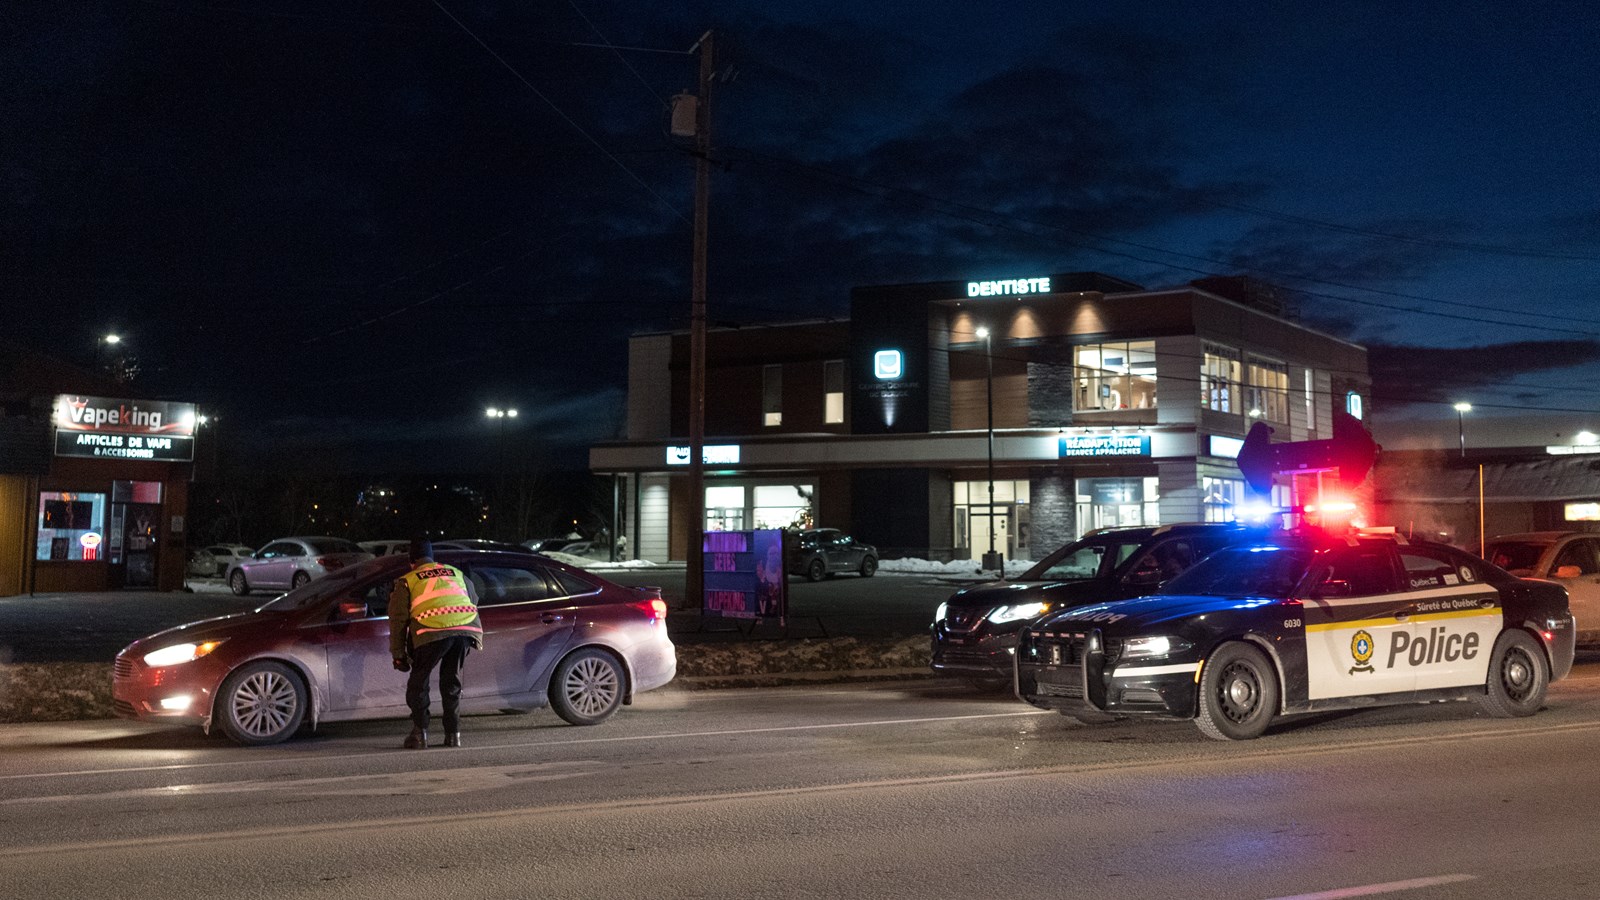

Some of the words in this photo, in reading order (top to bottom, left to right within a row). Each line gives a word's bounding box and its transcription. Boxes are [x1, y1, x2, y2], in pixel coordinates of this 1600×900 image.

[967, 277, 1051, 297] DENTISTE
[77, 434, 123, 447] ARTICLES
[128, 437, 142, 448] DE
[146, 438, 171, 449] VAPE
[94, 448, 99, 456] &
[101, 448, 153, 458] ACCESSOIRES
[1095, 447, 1141, 455] APPALACHES
[419, 569, 454, 578] POLICE
[1416, 601, 1440, 611] Sûreté
[1441, 601, 1451, 609] du
[1452, 599, 1478, 608] Québec
[1284, 619, 1302, 628] 6030
[1387, 626, 1480, 669] Police
